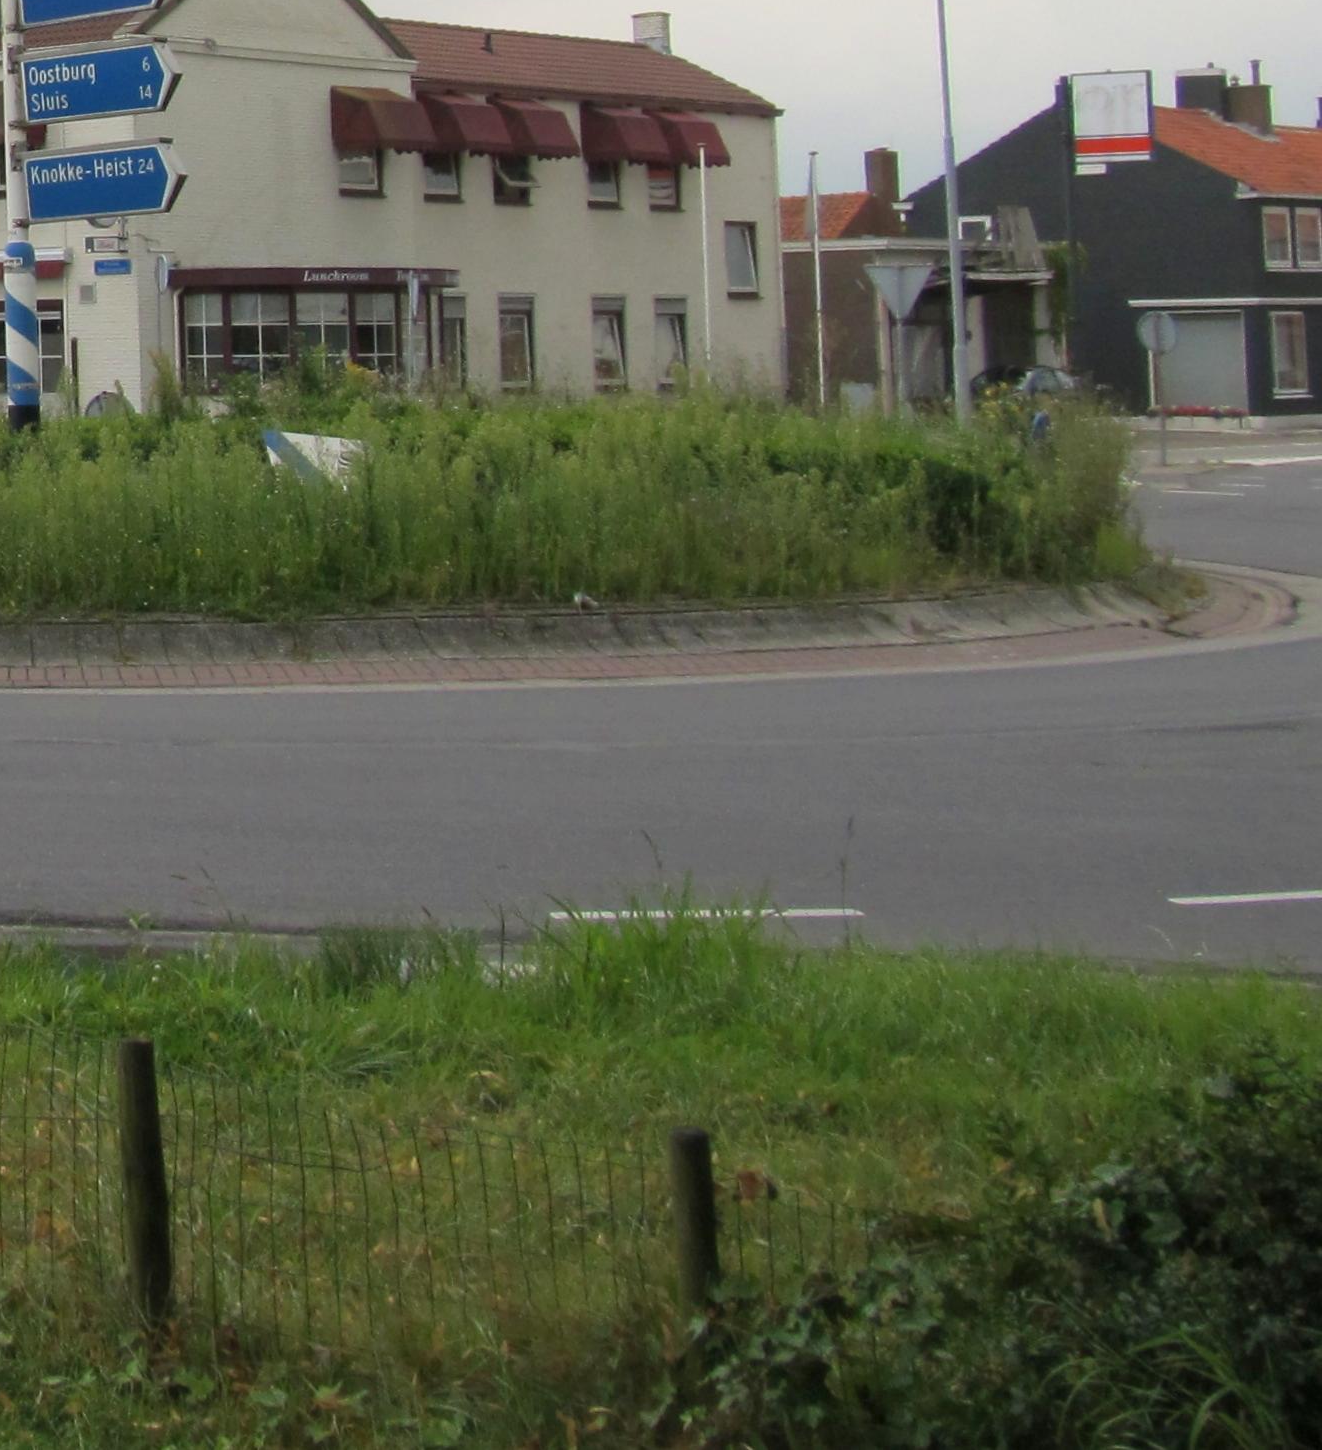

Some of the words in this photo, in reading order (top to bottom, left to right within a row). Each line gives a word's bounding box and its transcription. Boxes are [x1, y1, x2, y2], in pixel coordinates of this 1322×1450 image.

[29, 63, 96, 85] Oostburg
[142, 56, 151, 71] 6
[31, 91, 69, 112] Sluis
[139, 84, 153, 99] 14
[31, 156, 133, 185] Knokke-Heist
[138, 158, 154, 174] 24
[303, 269, 370, 282] Lunchroom
